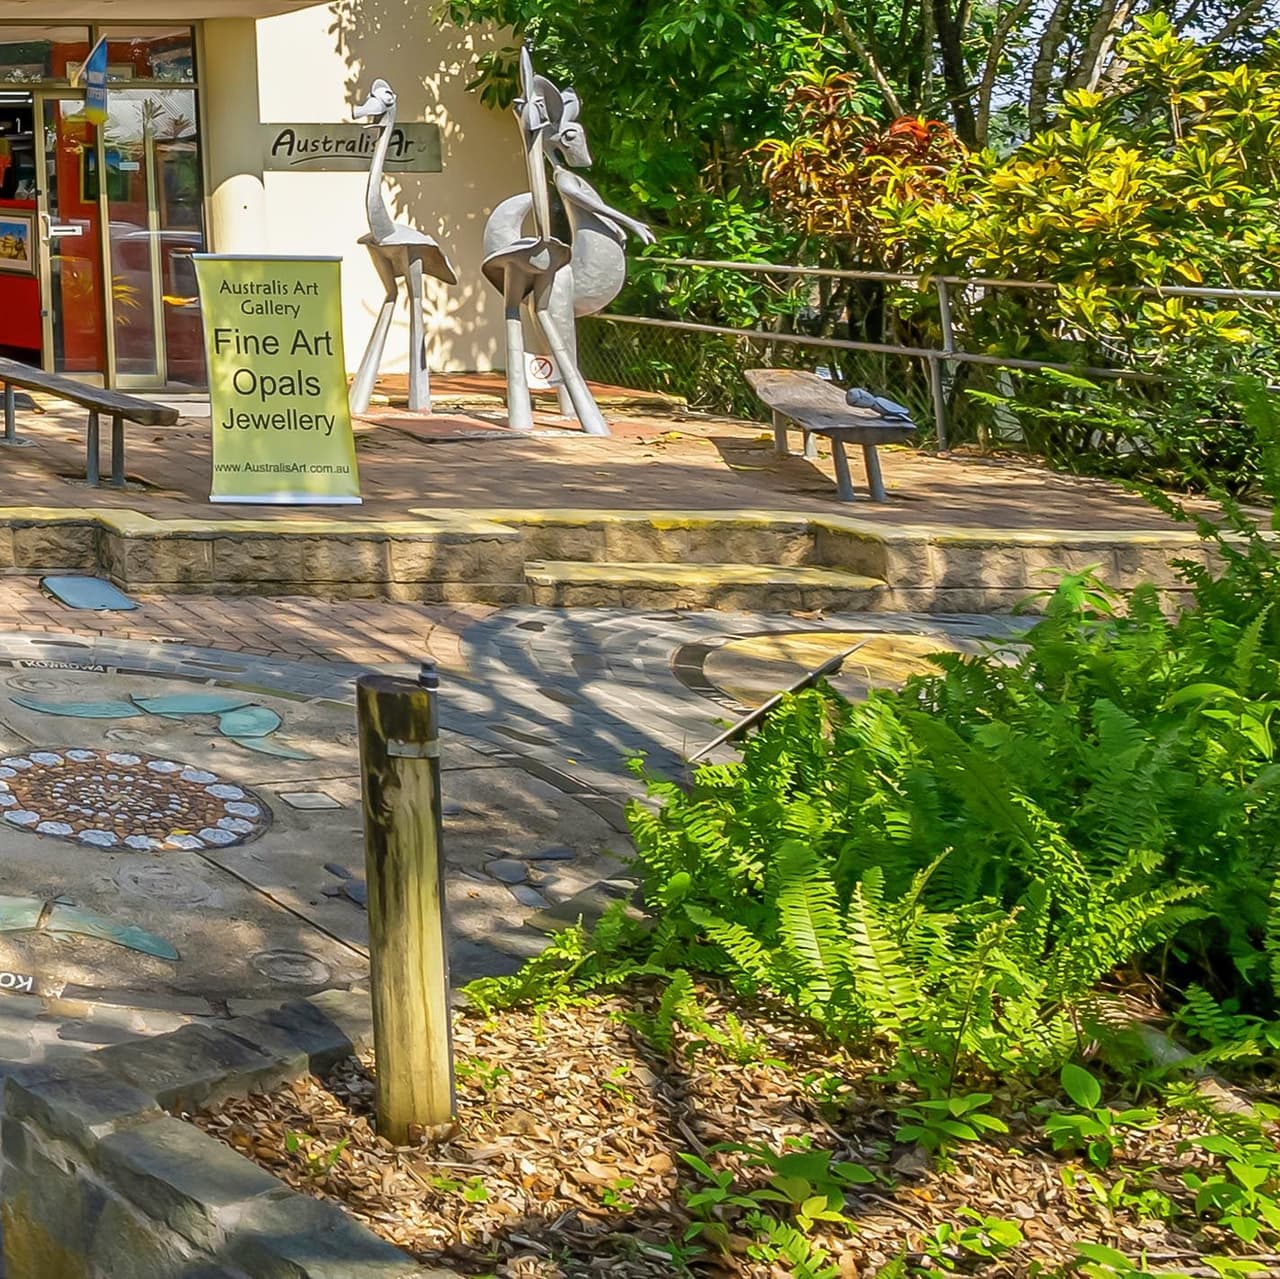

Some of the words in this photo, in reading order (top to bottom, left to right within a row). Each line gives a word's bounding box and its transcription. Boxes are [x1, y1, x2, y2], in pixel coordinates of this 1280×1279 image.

[219, 279, 288, 295] Australis
[293, 280, 319, 296] Art
[240, 299, 301, 318] Gallery
[214, 328, 279, 355] Fine
[290, 329, 333, 356] Art
[232, 368, 321, 402] Opals
[222, 408, 335, 436] Jewellery
